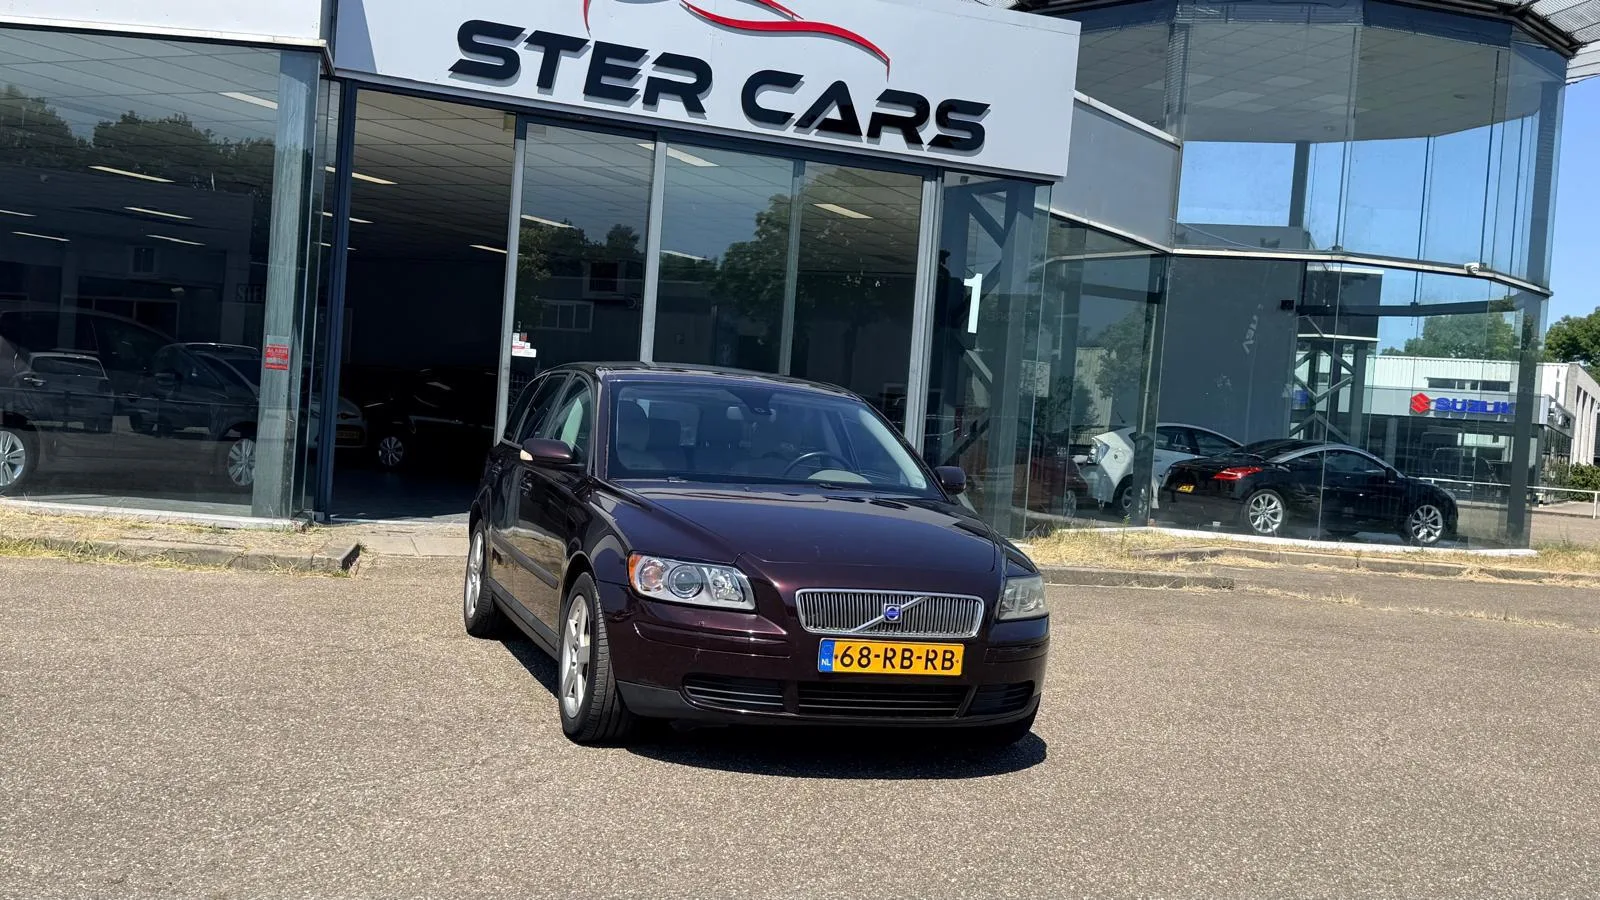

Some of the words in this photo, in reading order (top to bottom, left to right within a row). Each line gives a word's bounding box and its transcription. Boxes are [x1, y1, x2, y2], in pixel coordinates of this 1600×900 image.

[447, 19, 713, 115] STER
[740, 69, 992, 152] CARS
[963, 272, 983, 334] 1
[1435, 397, 1516, 414] SUZUK
[821, 658, 832, 666] NL
[839, 645, 956, 671] 68-RB-RB
